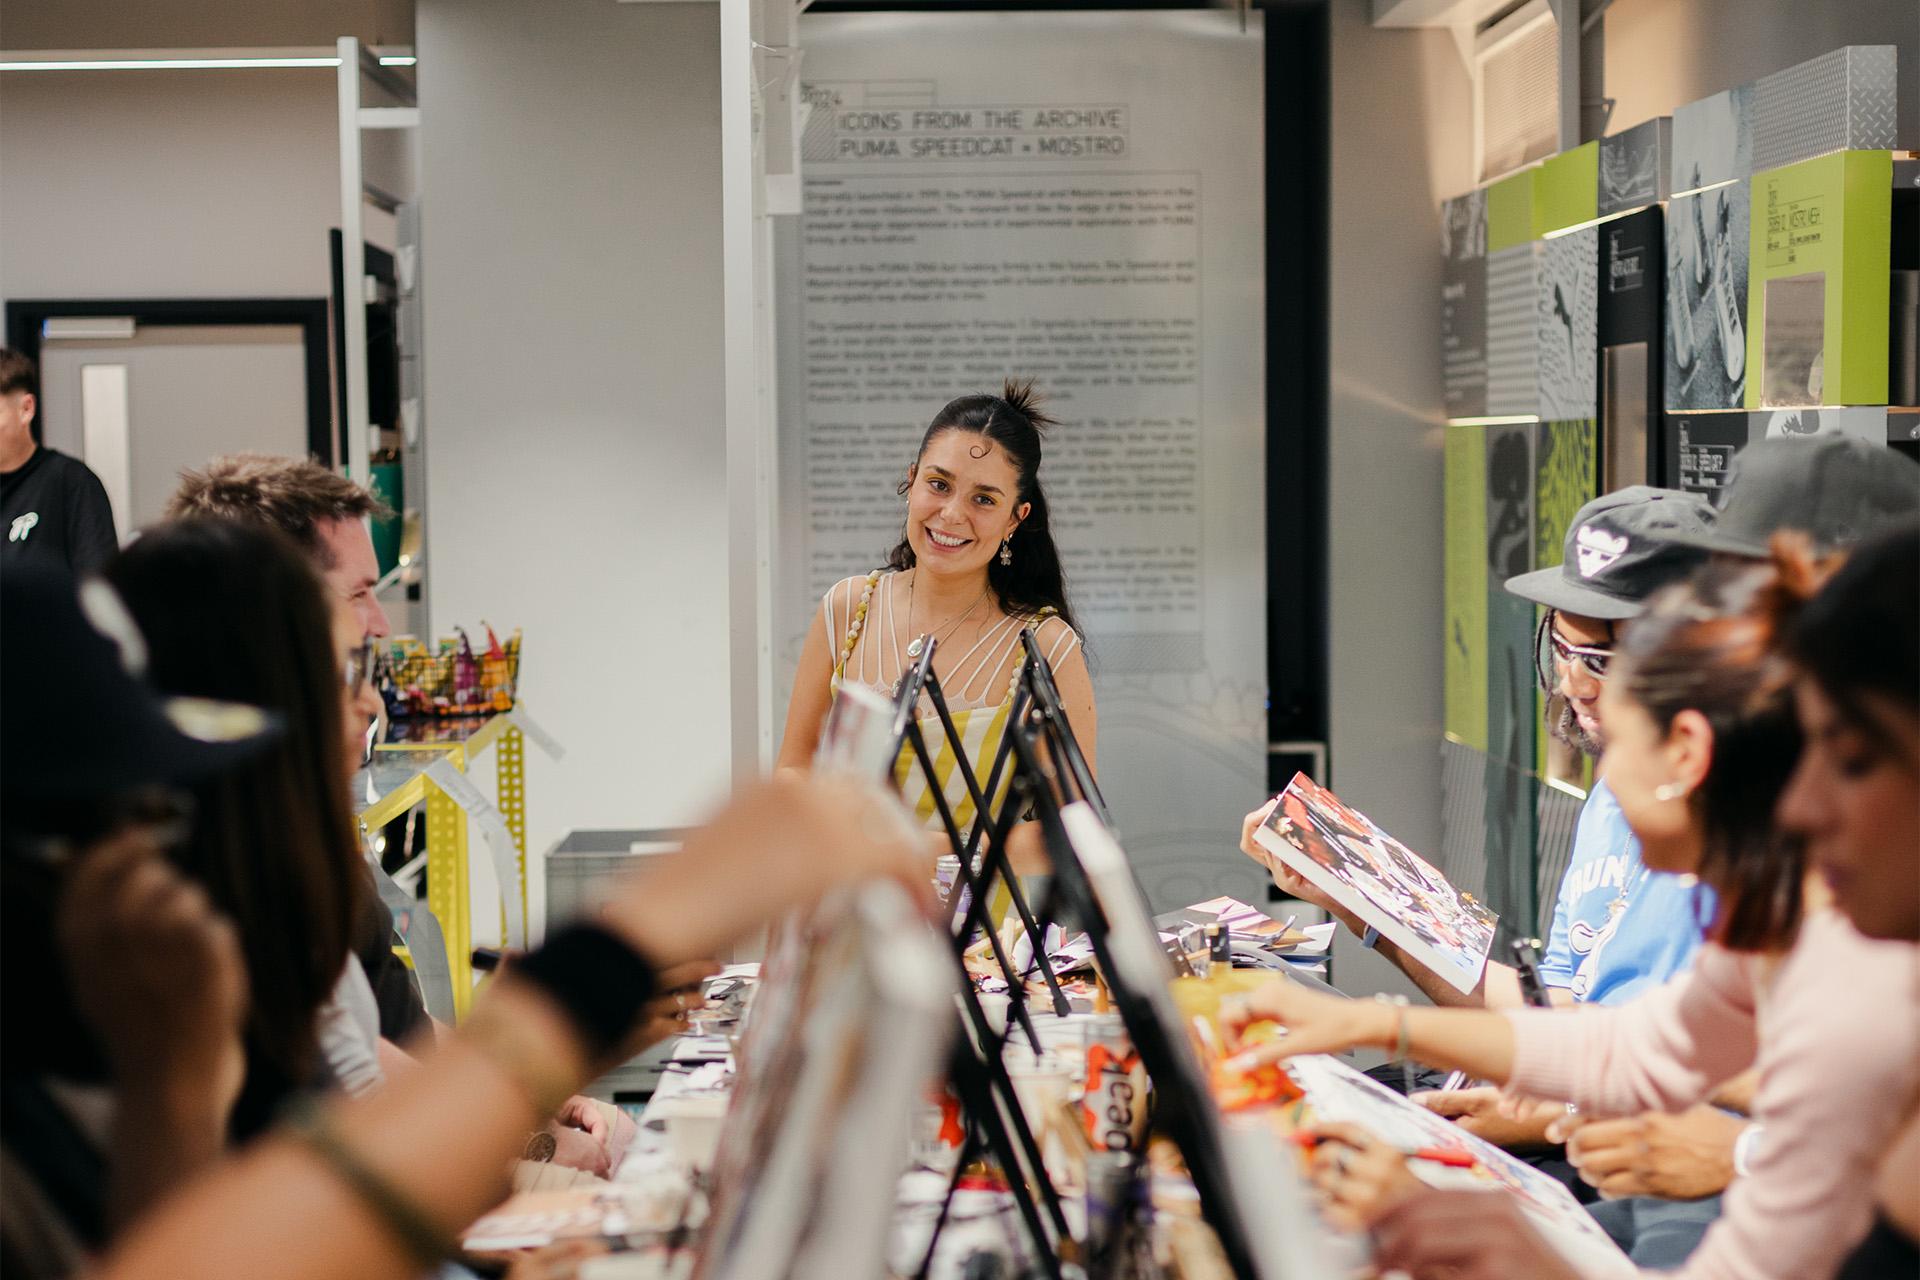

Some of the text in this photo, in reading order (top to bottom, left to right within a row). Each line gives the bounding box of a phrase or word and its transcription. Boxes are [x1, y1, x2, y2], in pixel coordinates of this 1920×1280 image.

[840, 109, 1121, 131] ICONS FROM THE ARCHIVE
[840, 138, 900, 157] PUMA
[909, 137, 1014, 157] SPEEDCAT
[1037, 135, 1126, 155] MOSTRO
